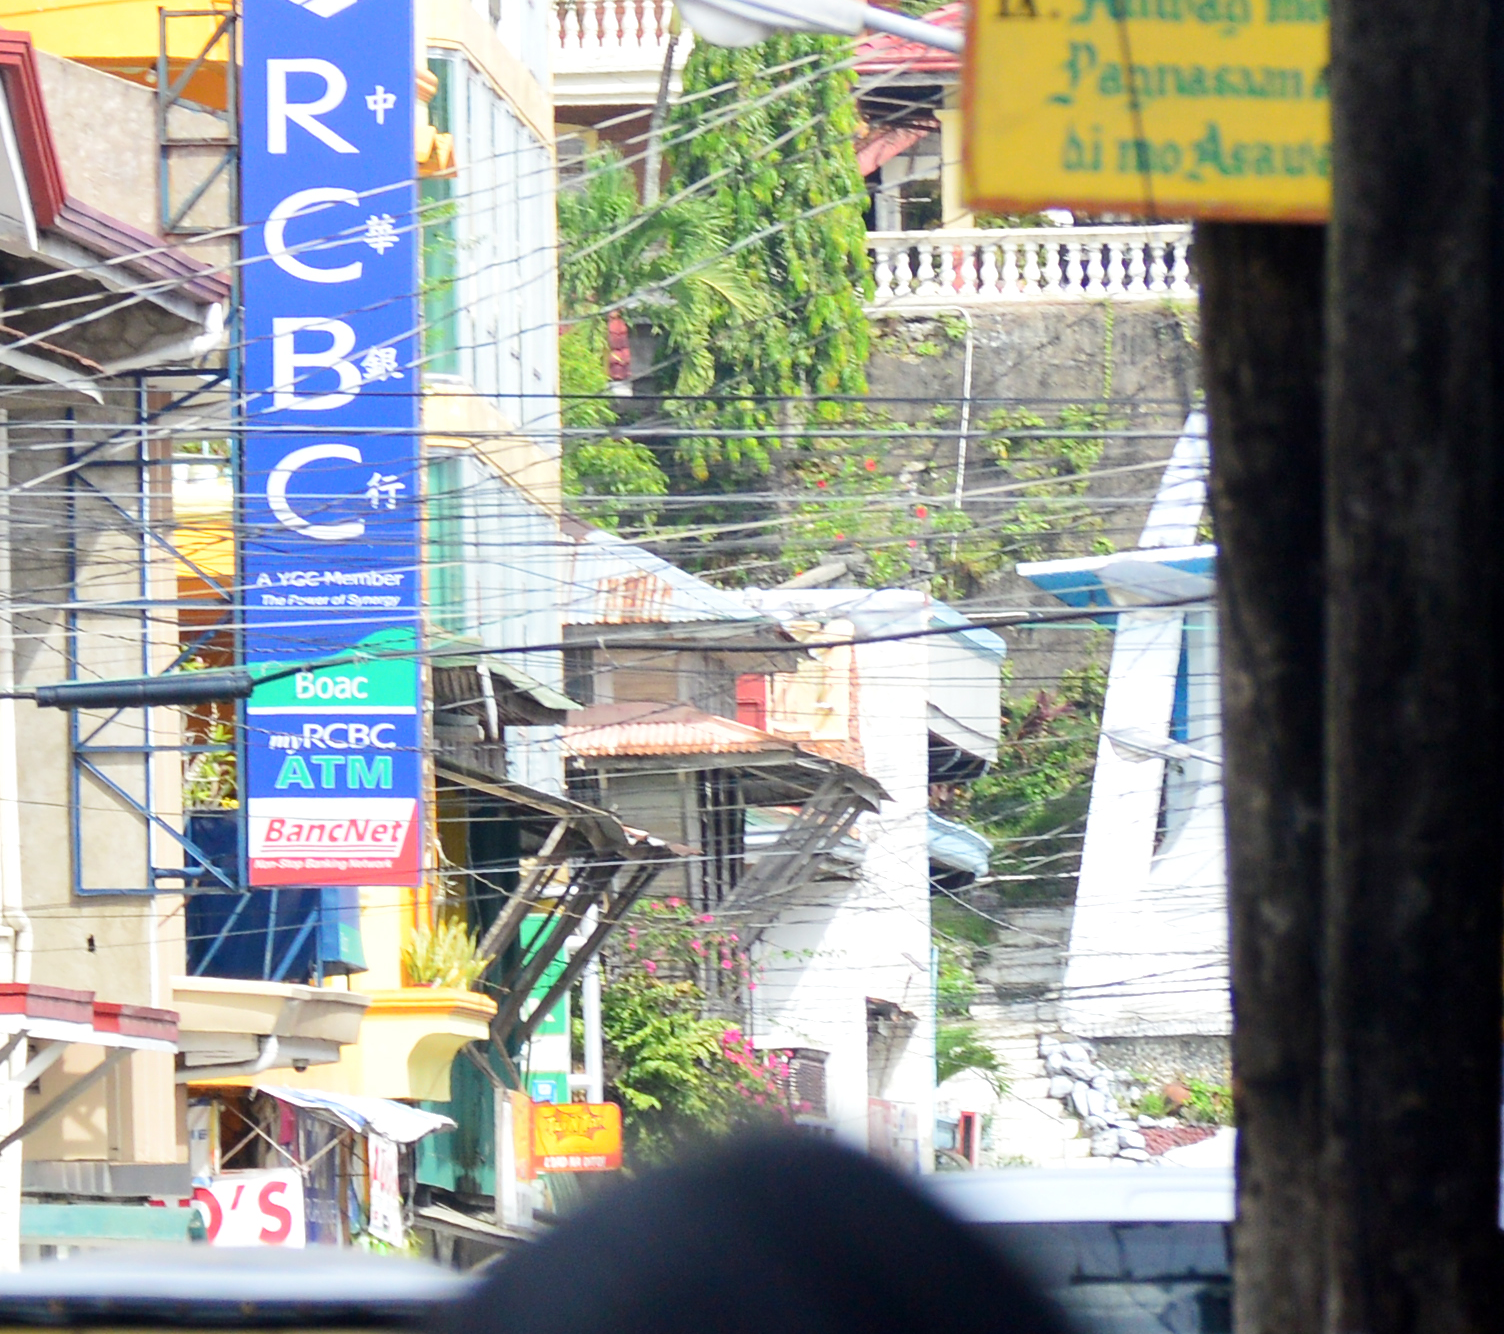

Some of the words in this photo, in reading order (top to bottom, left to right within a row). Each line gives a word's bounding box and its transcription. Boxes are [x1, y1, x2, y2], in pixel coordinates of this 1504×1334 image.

[264, 57, 366, 541] RCBC
[256, 571, 272, 587] A
[323, 571, 405, 587] Member
[295, 670, 369, 701] Boac
[274, 754, 394, 790] ATM
[264, 818, 402, 843] BancNet
